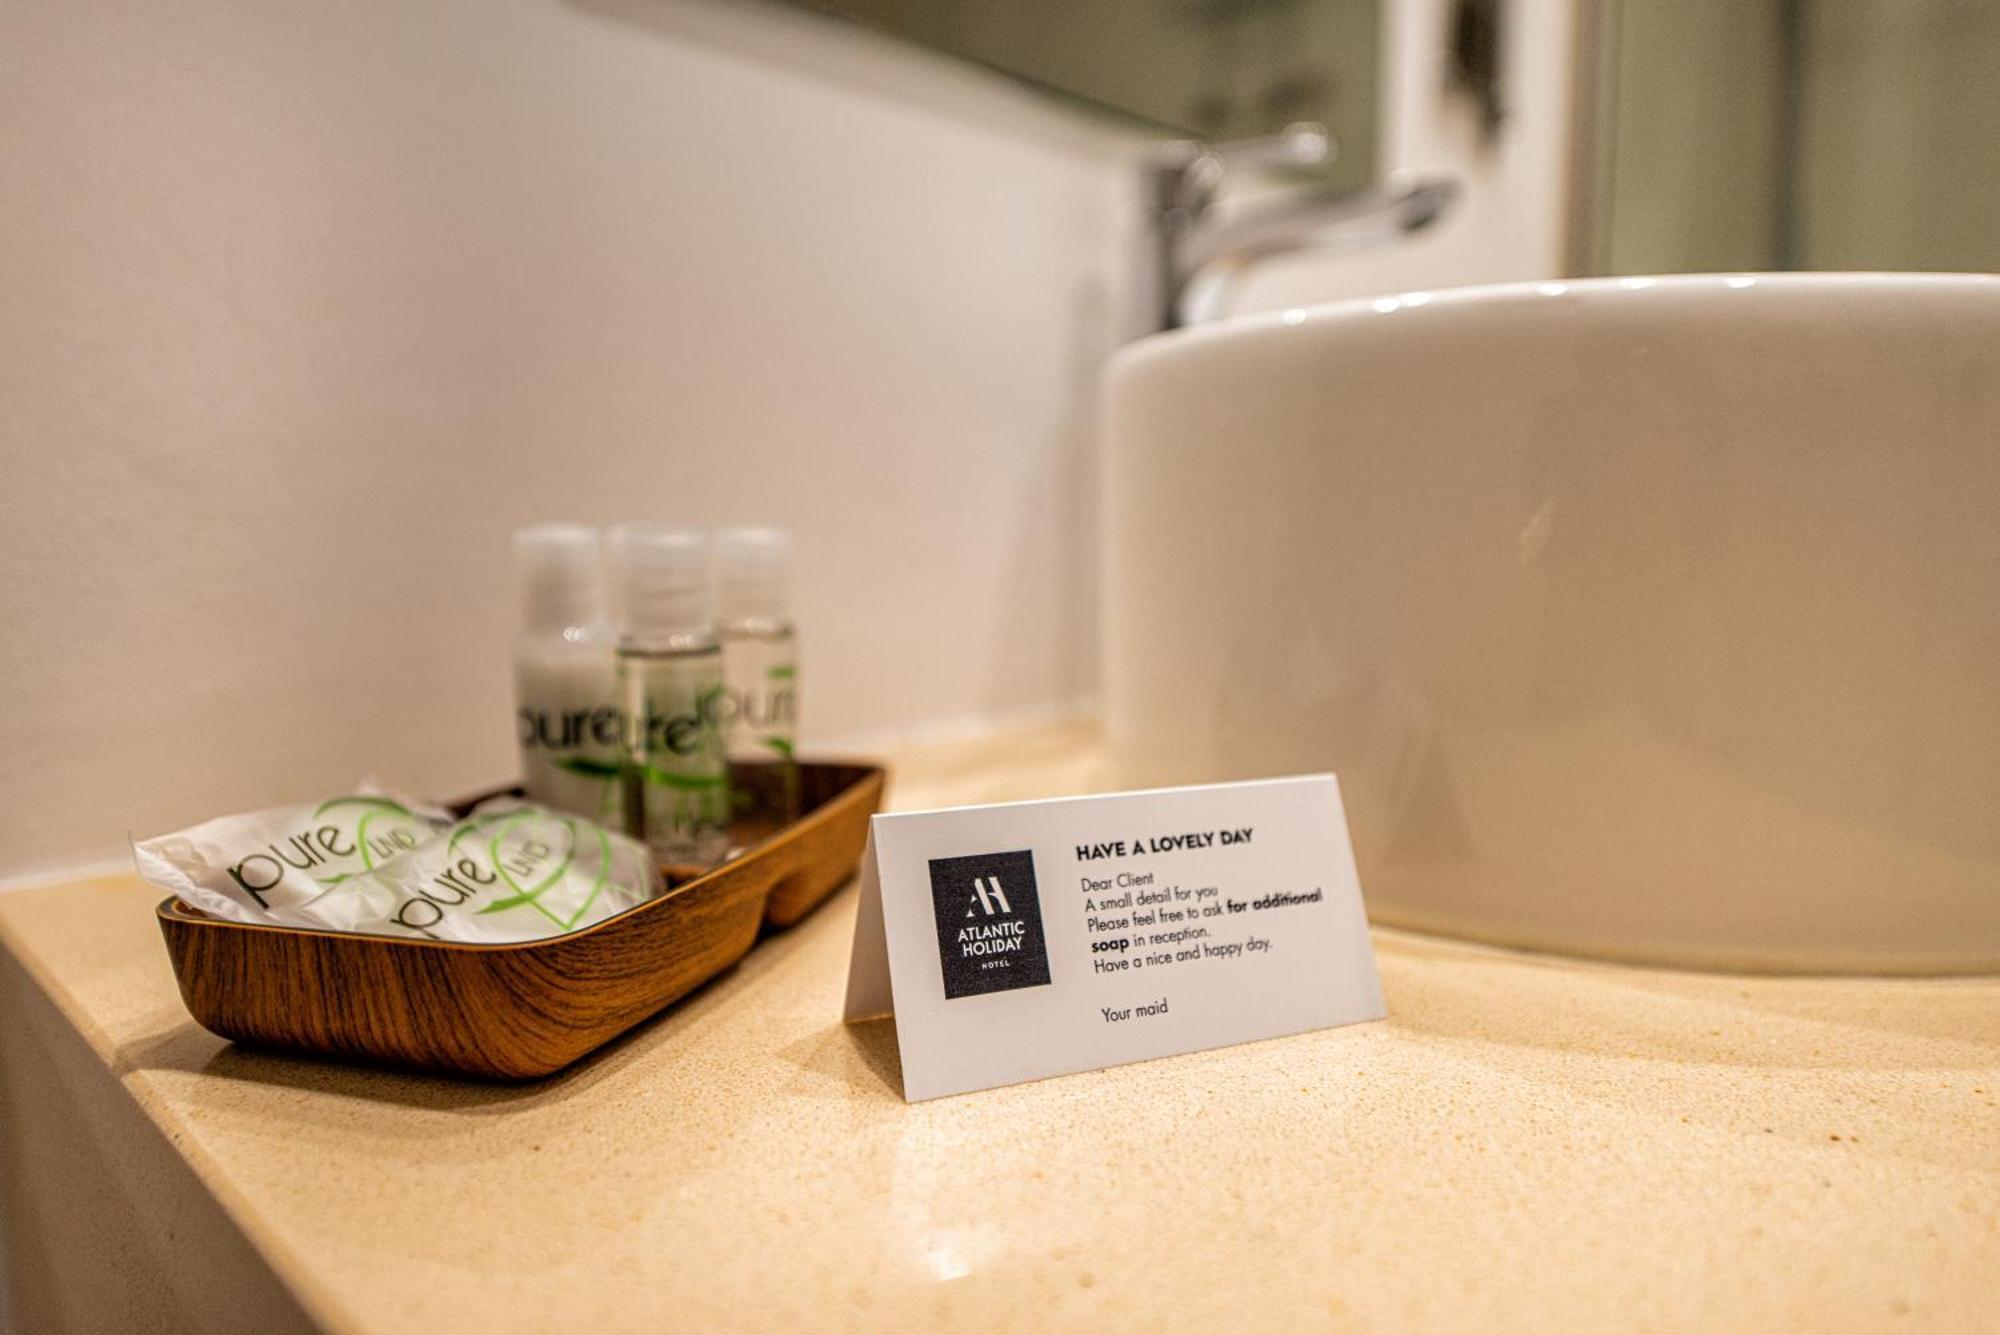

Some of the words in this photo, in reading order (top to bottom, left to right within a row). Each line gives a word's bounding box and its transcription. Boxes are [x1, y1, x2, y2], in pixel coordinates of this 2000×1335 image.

[1076, 841, 1127, 862] HAVE
[1132, 839, 1146, 855] A
[1150, 832, 1214, 853] LOVELY
[1220, 828, 1254, 845] DAY
[227, 825, 356, 909] pure
[1081, 877, 1112, 893] Dear
[1116, 872, 1154, 888] Client
[390, 857, 496, 939] pure
[1084, 898, 1096, 912] A
[1100, 892, 1133, 910] small
[1136, 887, 1171, 907] detail
[1174, 885, 1191, 900] for
[1195, 886, 1218, 901] you
[1087, 915, 1129, 933] Please
[1133, 911, 1156, 926] feel
[1159, 908, 1184, 924] free
[1187, 907, 1200, 919] to
[1203, 903, 1224, 918] ask
[1227, 899, 1247, 914] for
[1252, 887, 1323, 910] additional
[958, 921, 1025, 942] ATLANTIC
[1091, 936, 1130, 954] soap
[1133, 934, 1145, 947] in
[1149, 926, 1211, 945] reception.
[963, 937, 1022, 957] HOLIDAY
[1094, 956, 1129, 974] Have
[1133, 957, 1142, 968] a
[1146, 952, 1172, 966] nice
[1176, 945, 1200, 962] and
[1204, 939, 1243, 958] happy
[1246, 936, 1273, 953] day.
[982, 960, 1010, 970] HOTEL
[1101, 1006, 1131, 1023] Your
[1136, 997, 1169, 1017] maid
